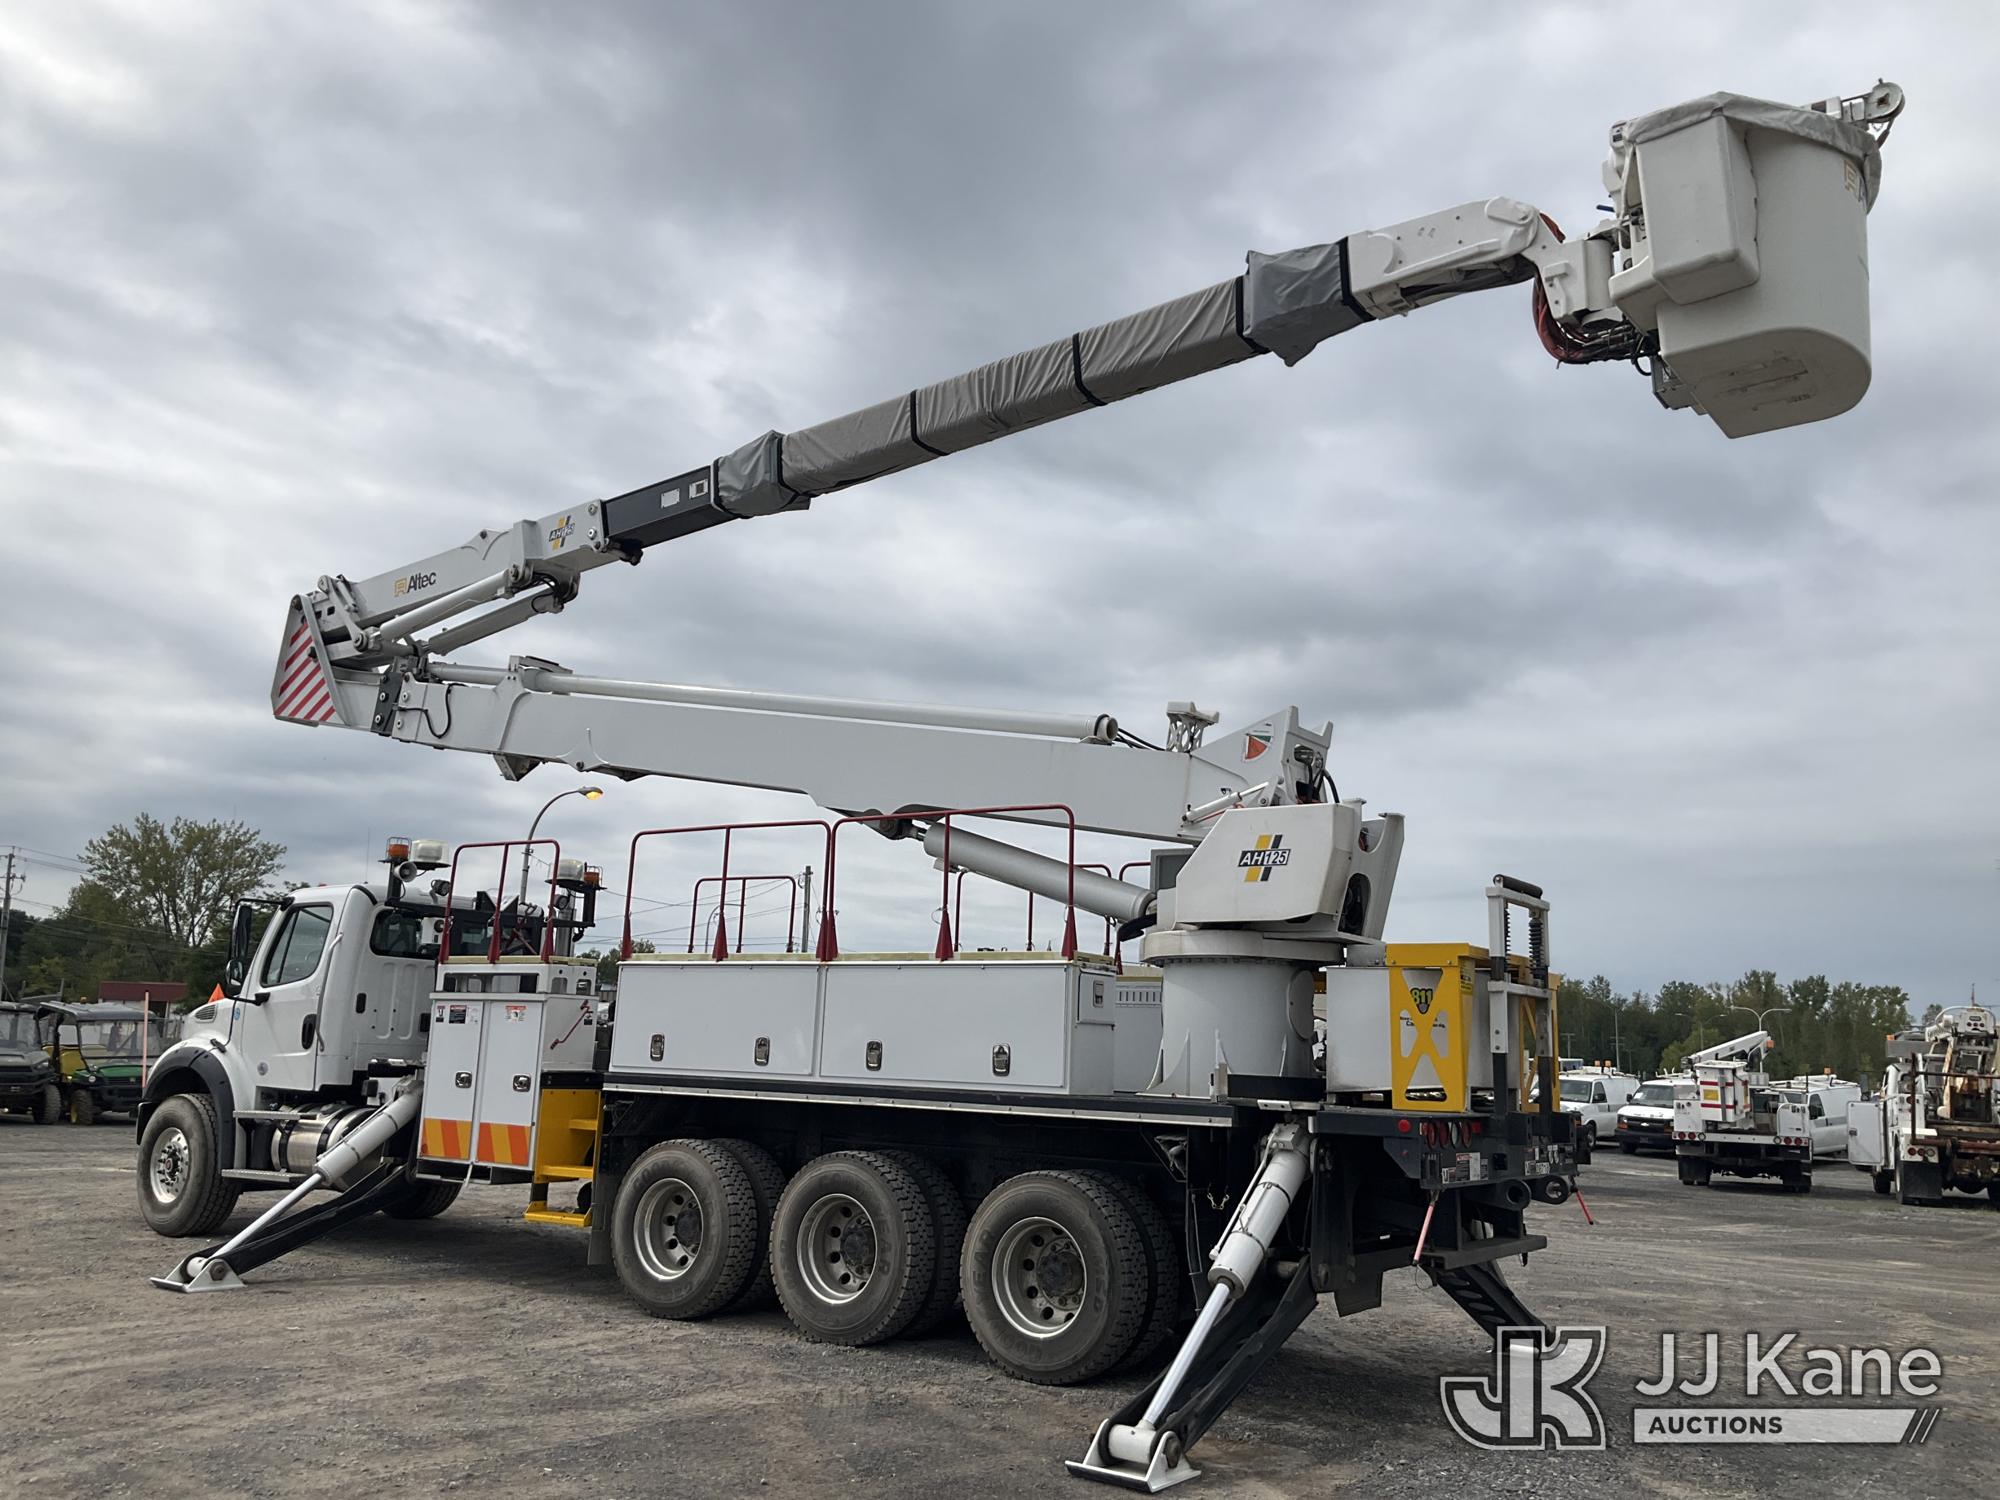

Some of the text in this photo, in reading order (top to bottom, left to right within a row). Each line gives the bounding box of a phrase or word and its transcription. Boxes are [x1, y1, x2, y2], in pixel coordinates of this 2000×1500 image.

[406, 571, 437, 594] Altec
[1238, 849, 1291, 867] AH125
[1410, 987, 1433, 1006] 811
